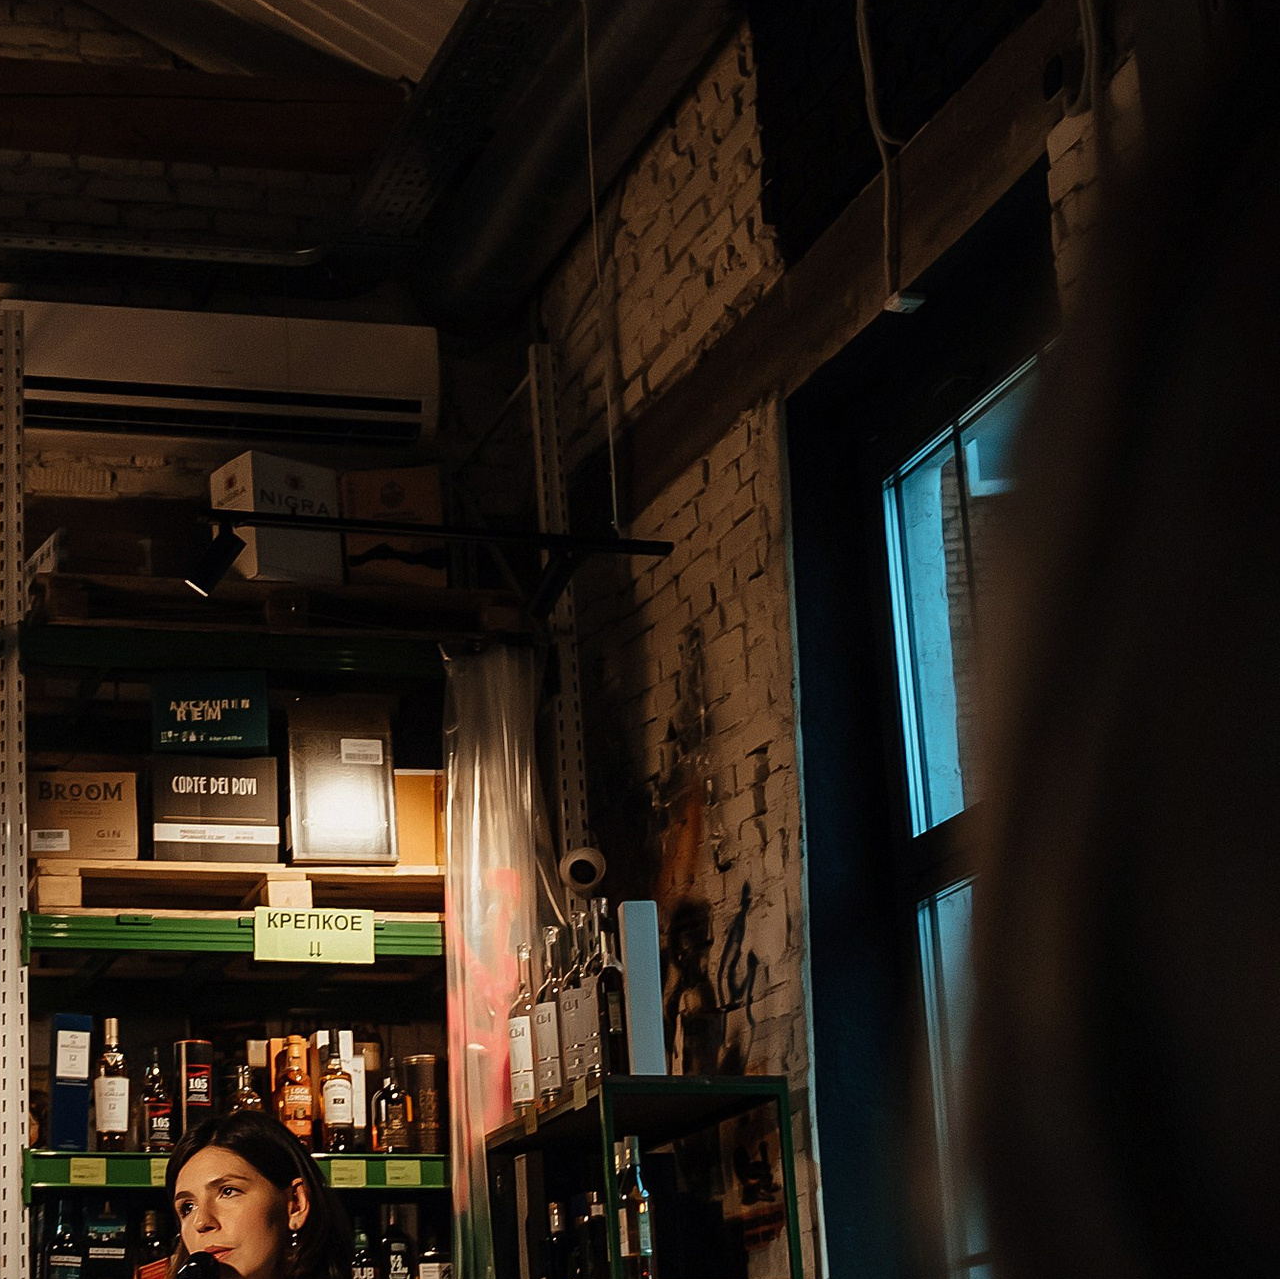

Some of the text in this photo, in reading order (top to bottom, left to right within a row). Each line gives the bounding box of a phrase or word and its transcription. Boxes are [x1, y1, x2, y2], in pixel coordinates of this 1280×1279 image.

[261, 489, 330, 516] NIGRA
[39, 781, 125, 802] BROOM
[171, 775, 257, 795] CORTE DEI ROVI
[96, 829, 121, 839] GIN
[267, 912, 362, 931] КРЕПКОЕ
[188, 1078, 208, 1090] 105
[152, 1117, 170, 1129] 105
